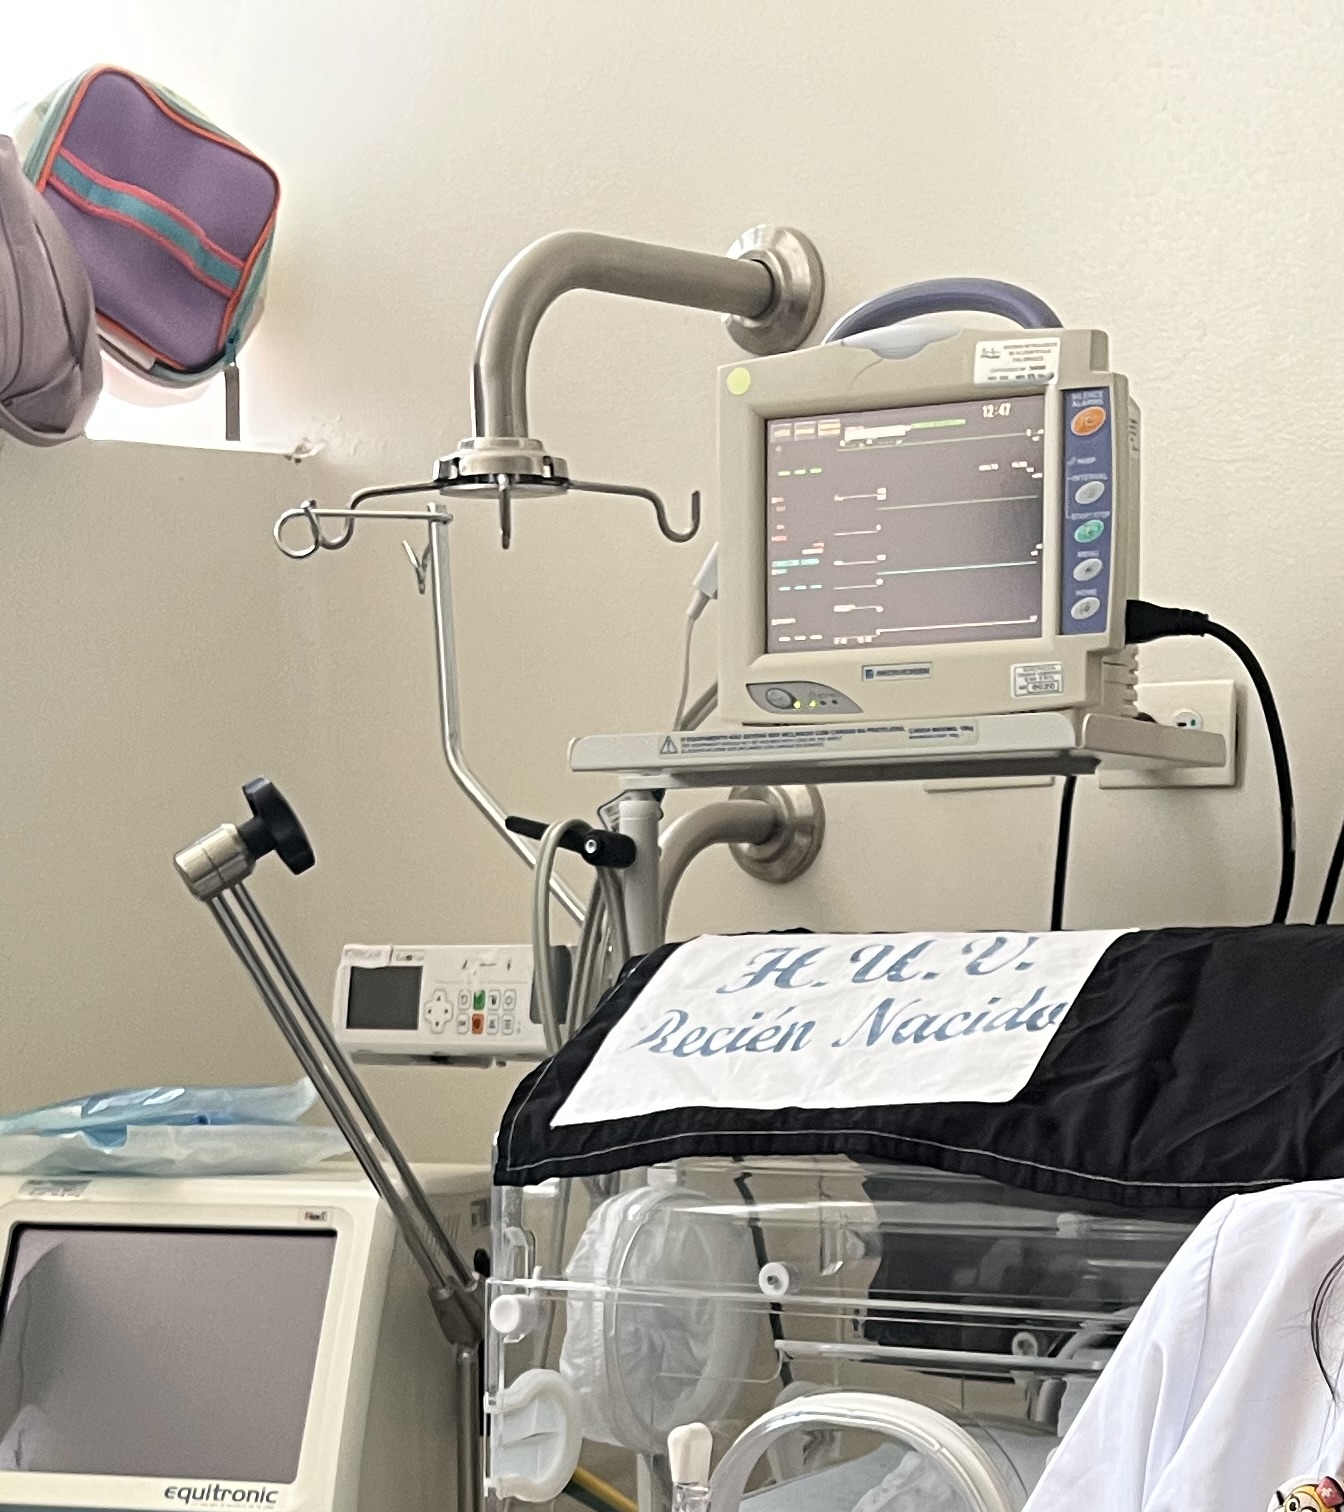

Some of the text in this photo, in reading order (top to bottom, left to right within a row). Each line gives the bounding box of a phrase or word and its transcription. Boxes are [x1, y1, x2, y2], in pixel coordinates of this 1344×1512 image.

[982, 402, 1011, 418] 12:47
[626, 986, 1068, 1058] Recién Nacido
